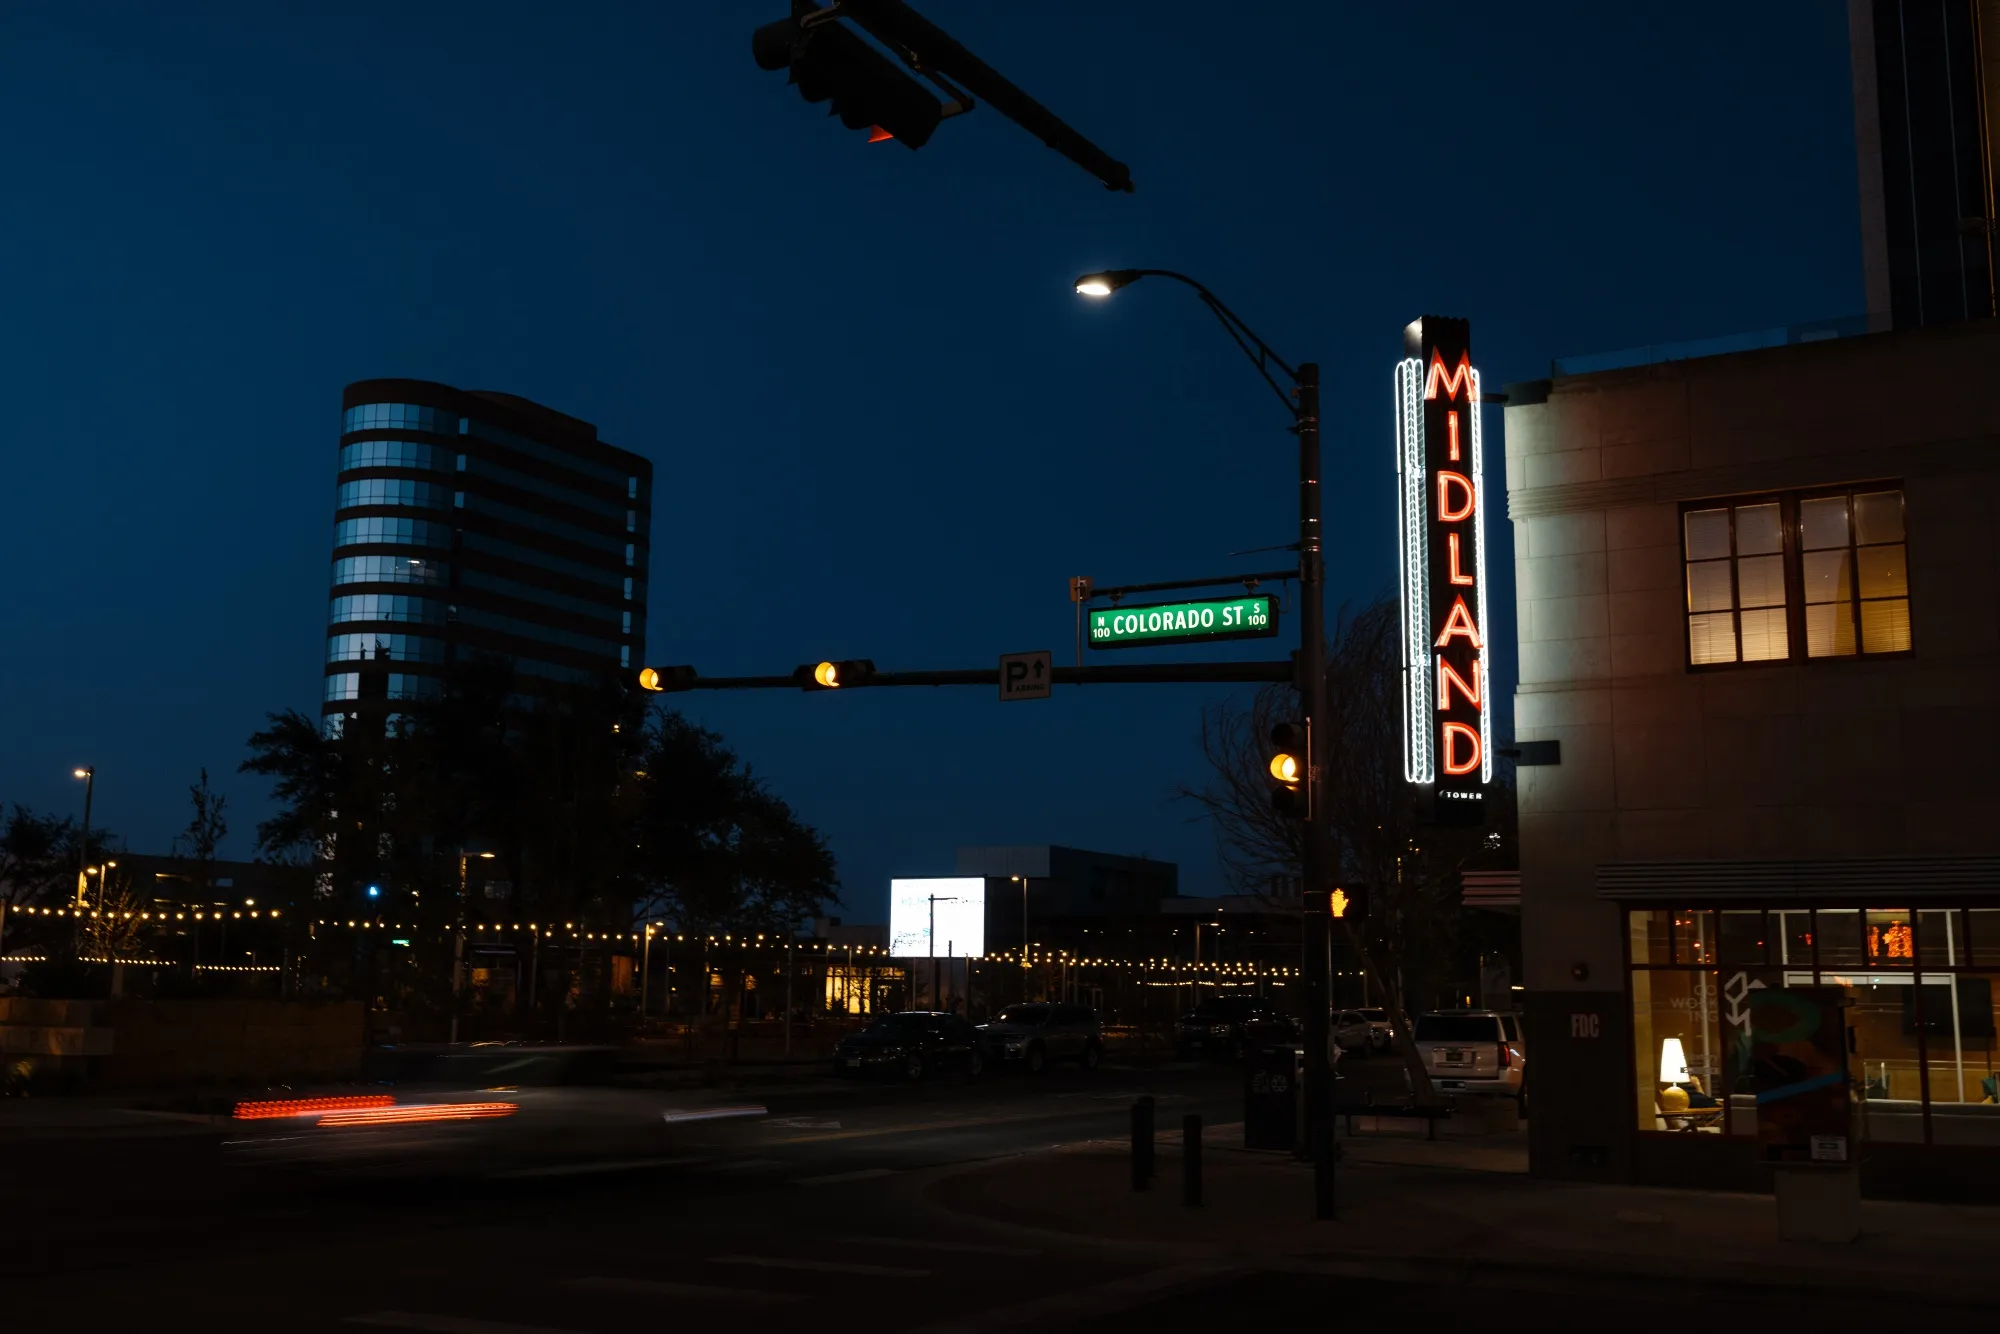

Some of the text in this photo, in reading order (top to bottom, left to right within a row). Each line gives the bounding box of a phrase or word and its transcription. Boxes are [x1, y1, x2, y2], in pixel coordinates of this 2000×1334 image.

[1423, 345, 1483, 775] MIDLAND
[1253, 603, 1260, 614] S
[1097, 616, 1105, 627] N
[1113, 605, 1244, 634] COLORADO ST
[1248, 614, 1267, 626] 100
[1093, 627, 1110, 638] 100
[1446, 791, 1483, 800] TOWER
[1570, 1013, 1600, 1038] FDC
